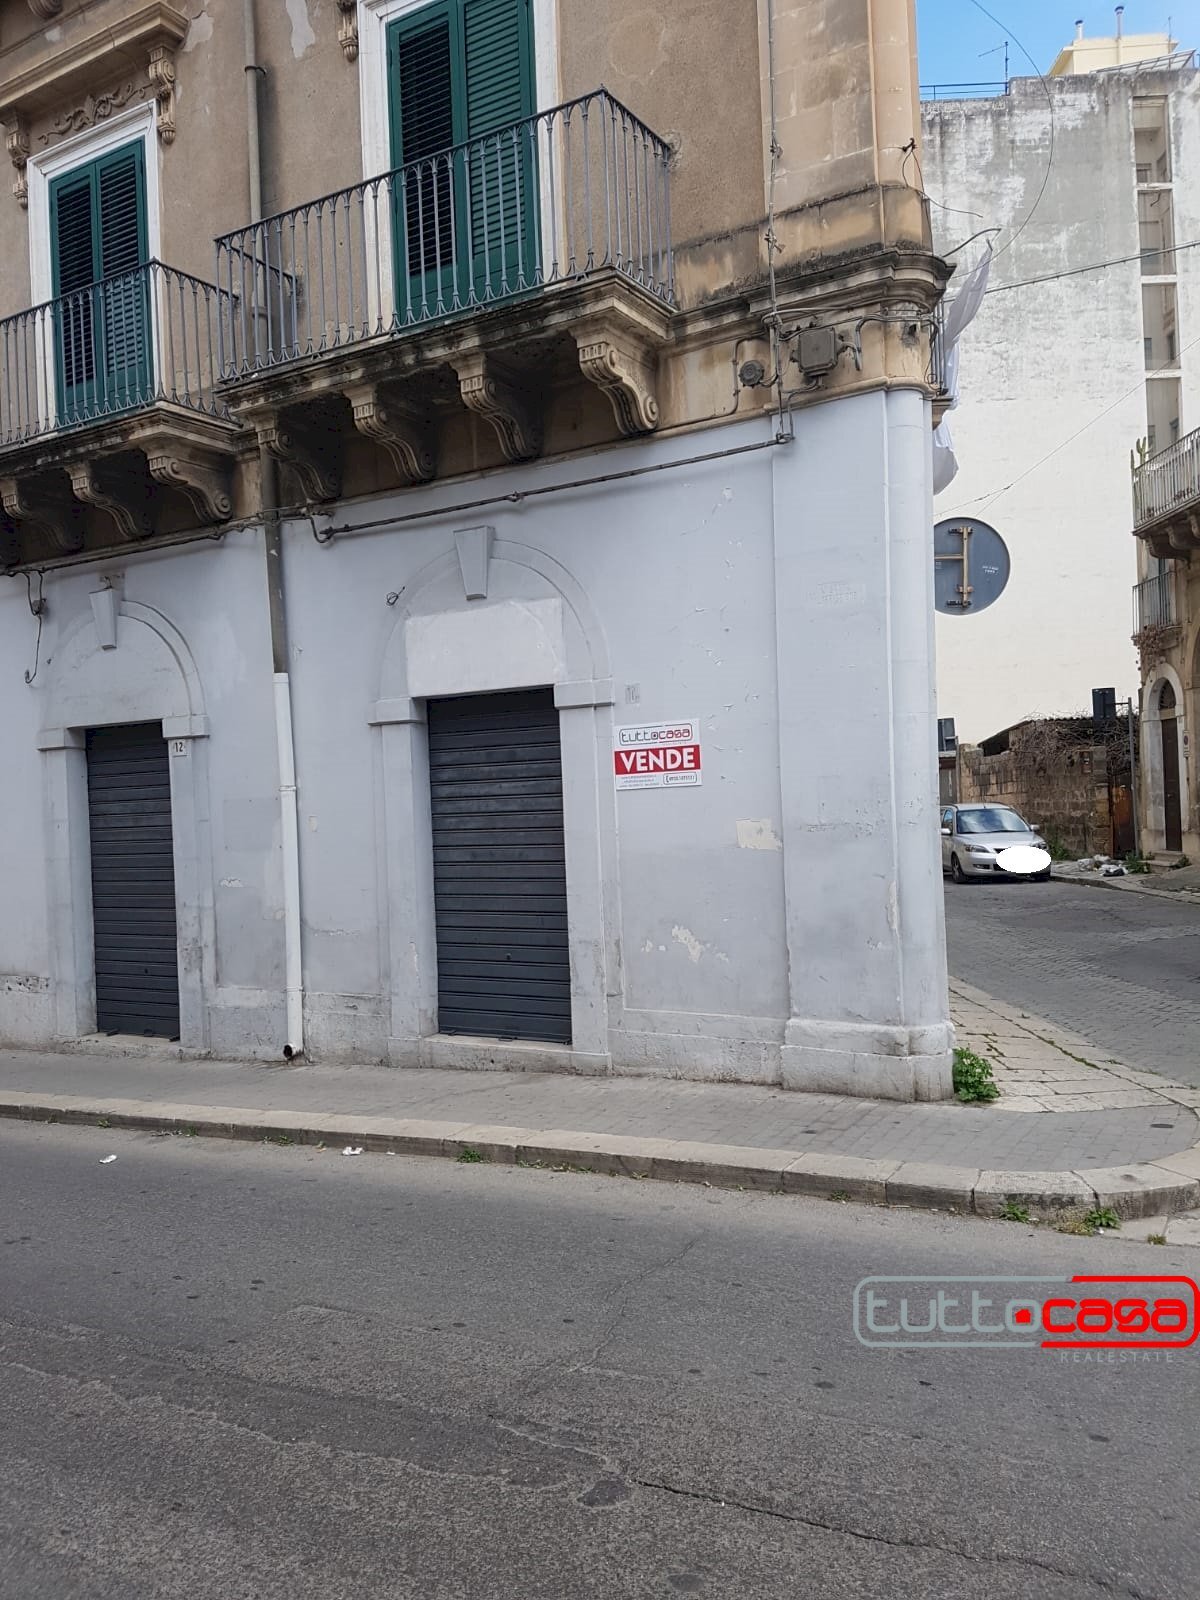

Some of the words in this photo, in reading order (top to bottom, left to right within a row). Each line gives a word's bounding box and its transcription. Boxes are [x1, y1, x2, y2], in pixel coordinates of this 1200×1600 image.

[621, 729, 690, 742] tuttocasa
[175, 742, 183, 752] 12
[620, 747, 695, 772] VENDE
